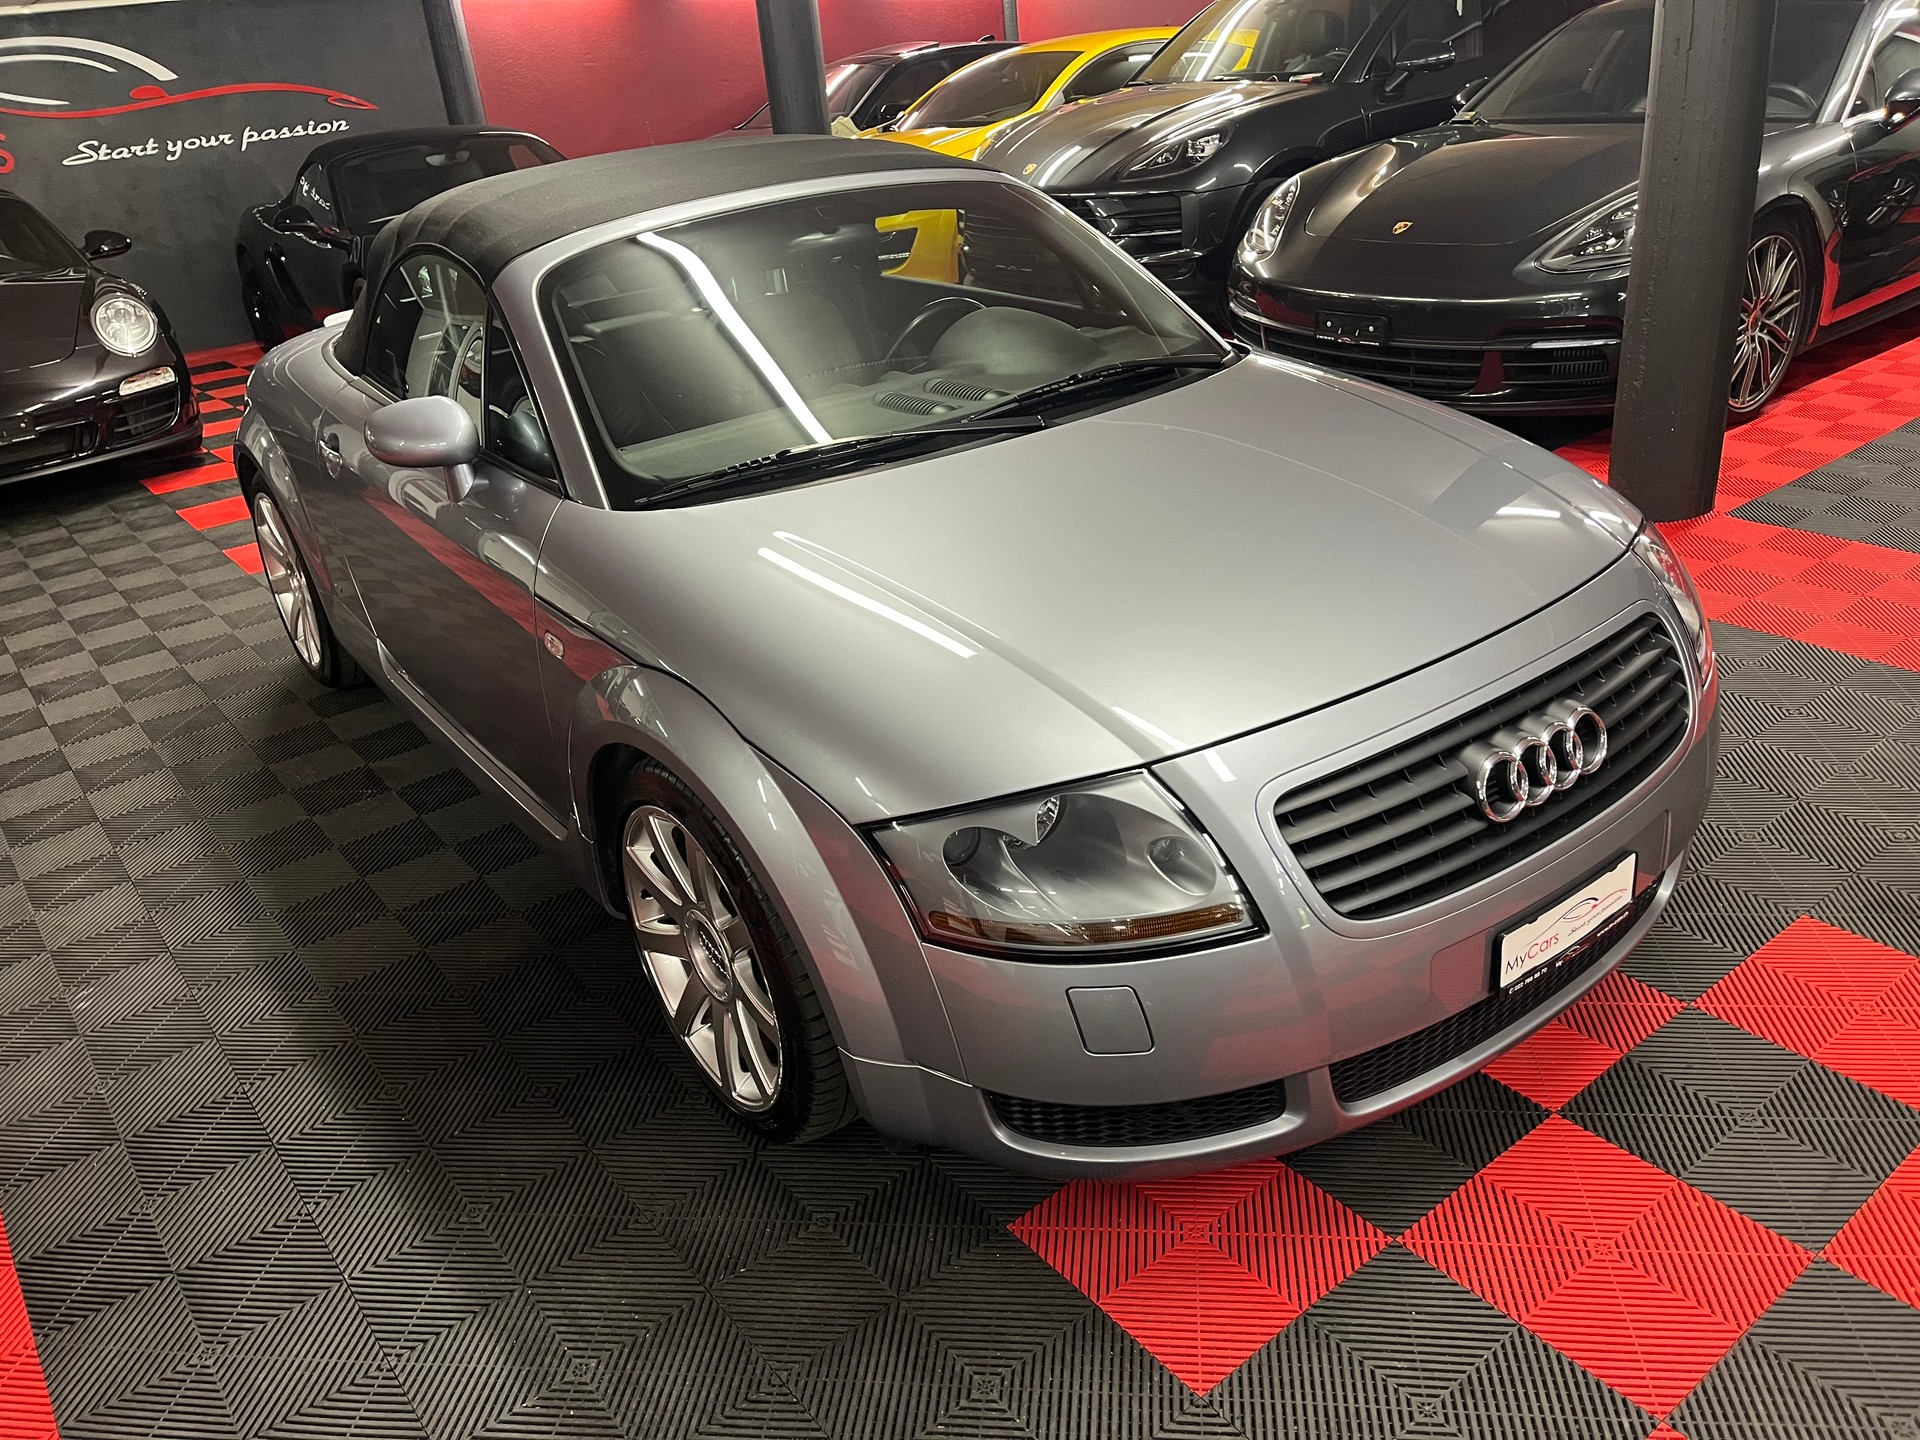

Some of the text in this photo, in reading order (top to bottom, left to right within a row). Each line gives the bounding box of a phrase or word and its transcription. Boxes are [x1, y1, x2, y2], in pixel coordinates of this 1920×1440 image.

[61, 119, 350, 166] Start your passion
[1505, 933, 1560, 975] MyCars
